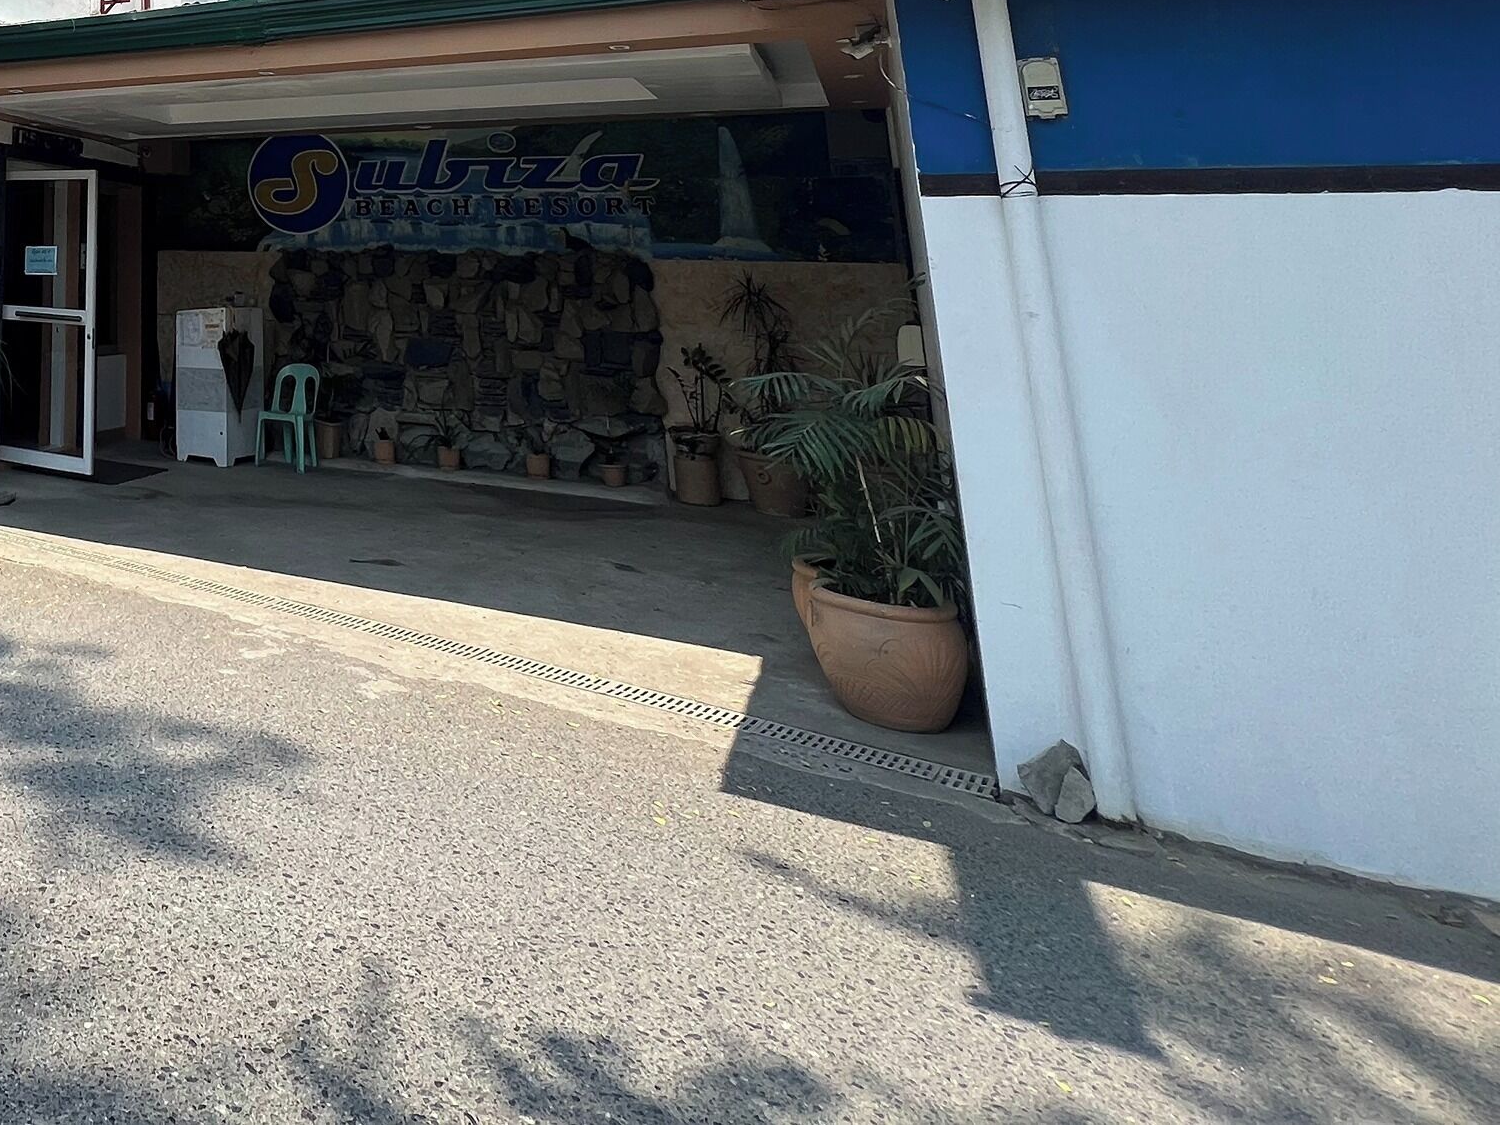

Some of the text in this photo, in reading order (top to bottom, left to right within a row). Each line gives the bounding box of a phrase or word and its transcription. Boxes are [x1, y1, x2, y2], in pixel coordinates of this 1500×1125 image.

[252, 131, 661, 217] Subiza
[355, 193, 658, 217] BEACH RESORT
